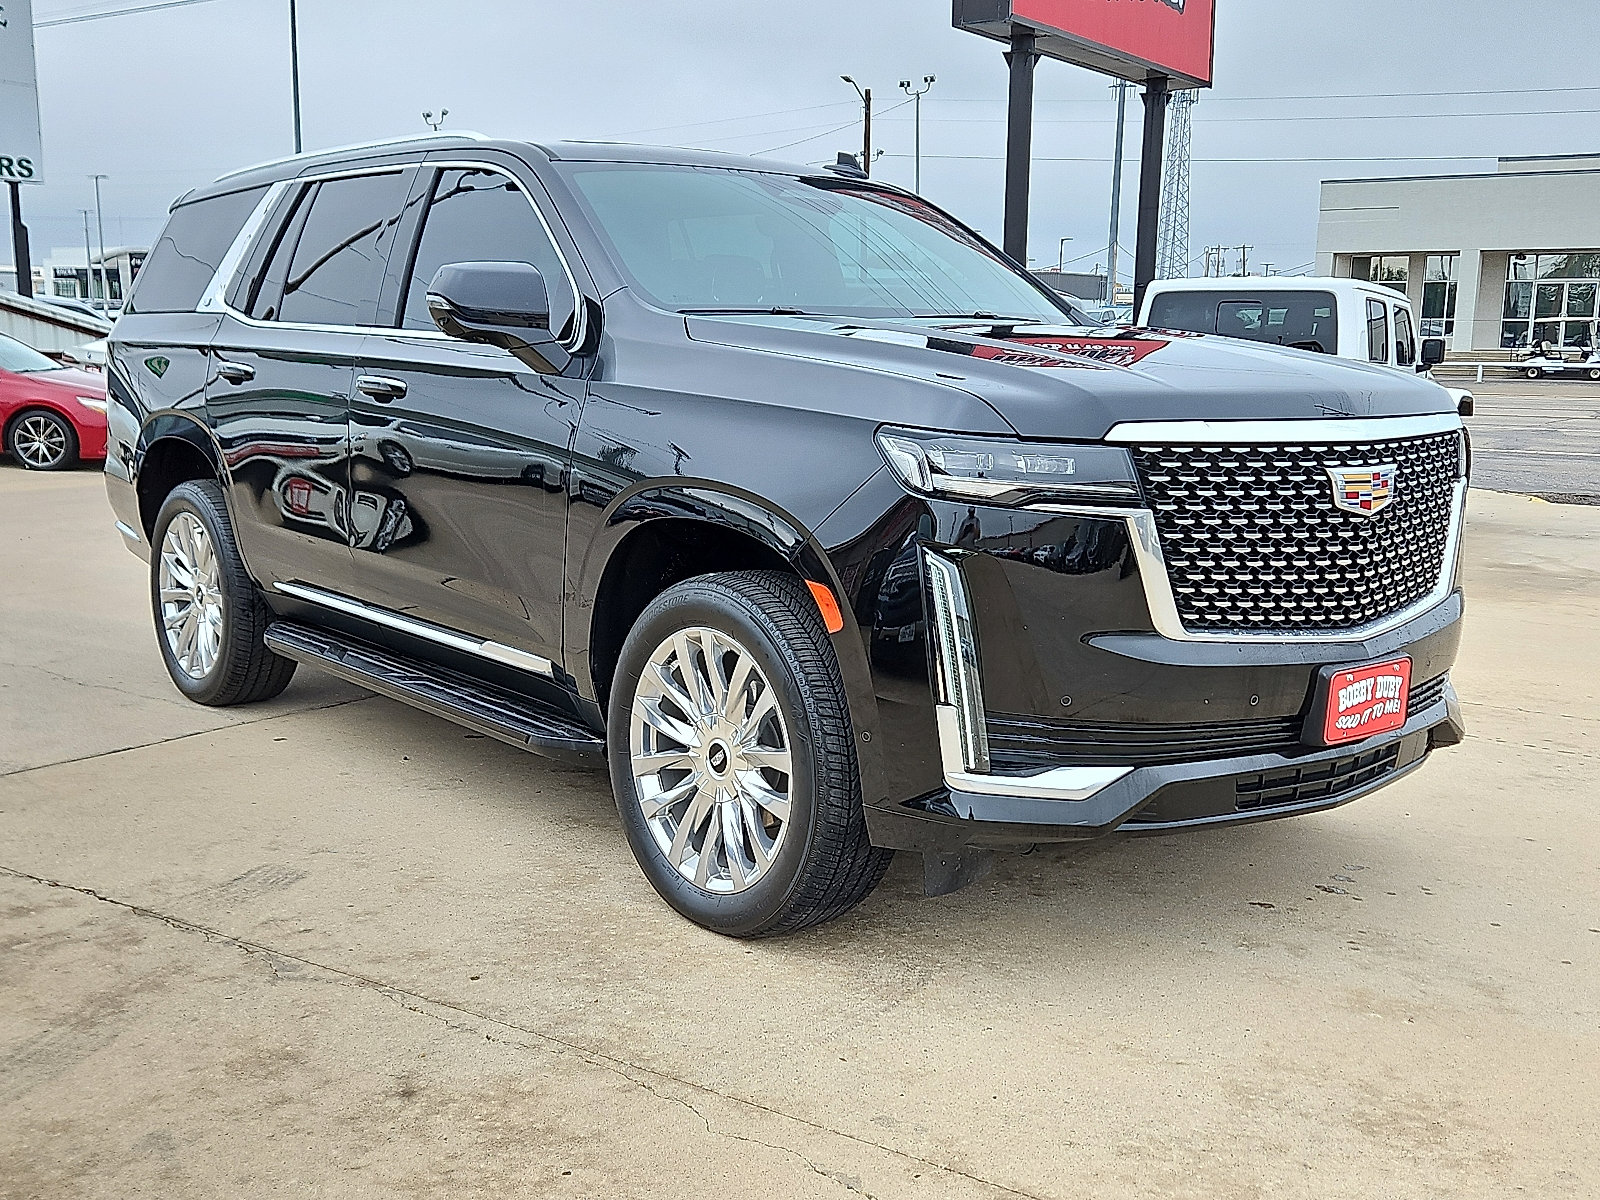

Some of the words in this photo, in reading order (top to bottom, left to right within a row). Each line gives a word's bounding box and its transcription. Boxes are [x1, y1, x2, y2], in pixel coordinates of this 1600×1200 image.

[0, 156, 34, 179] RS
[1338, 677, 1375, 713] BOBBY
[1375, 675, 1404, 699] DUBY
[1335, 713, 1361, 729] SOLD
[1360, 707, 1373, 726] IT
[1371, 702, 1384, 720] TO
[1384, 699, 1401, 715] ME!
